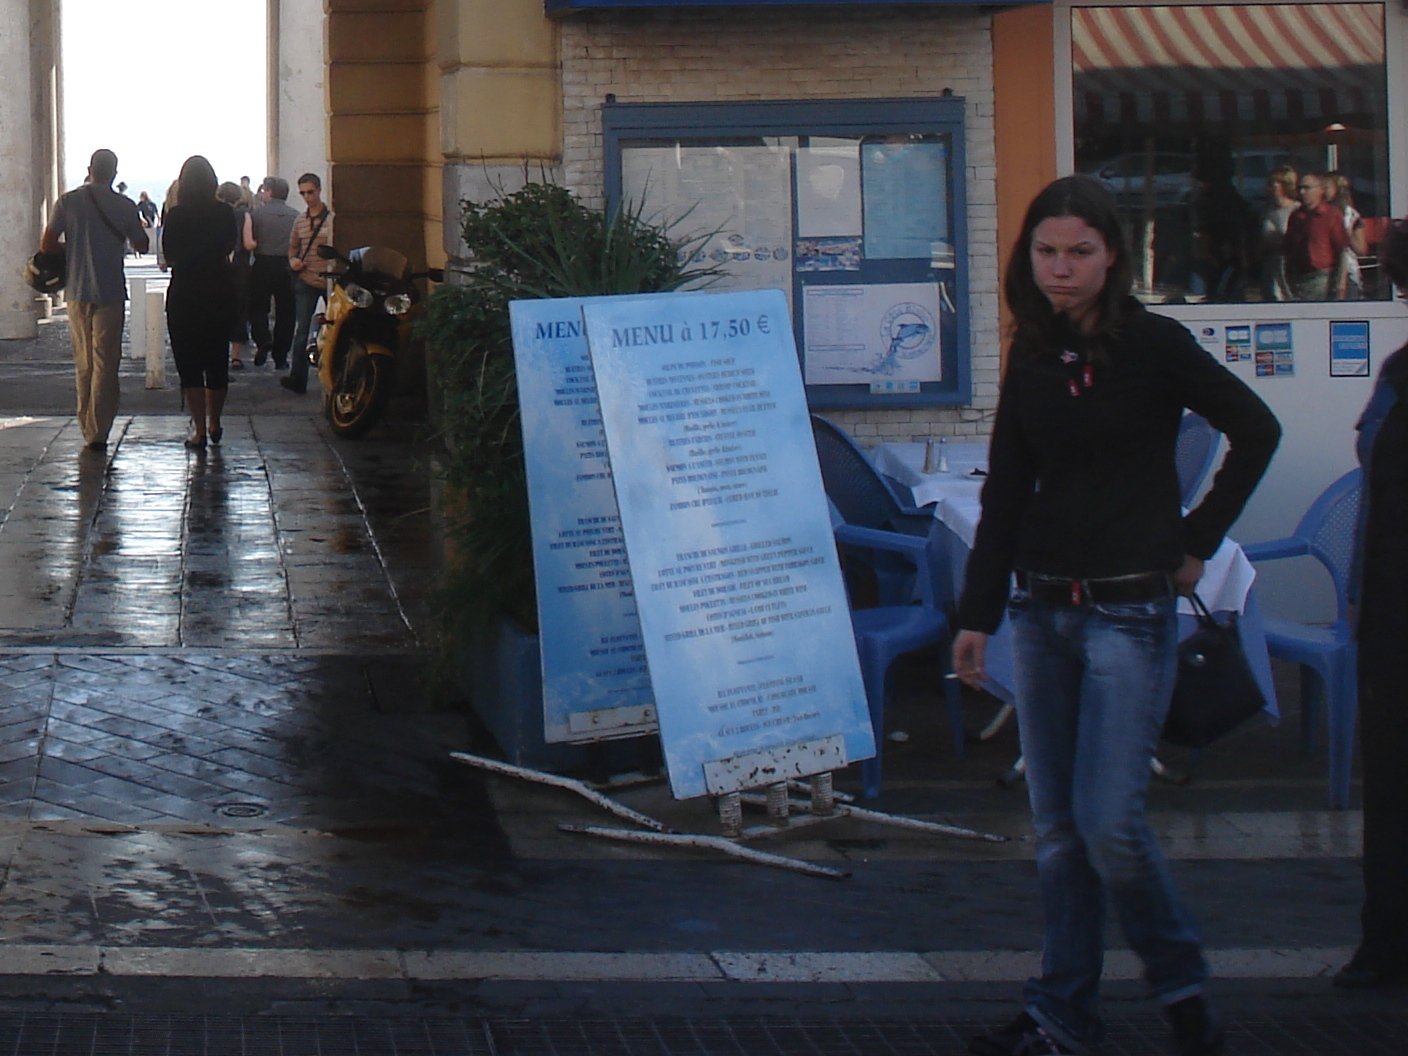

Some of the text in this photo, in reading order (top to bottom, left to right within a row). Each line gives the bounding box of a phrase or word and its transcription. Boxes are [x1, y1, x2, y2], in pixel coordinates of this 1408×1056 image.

[612, 314, 771, 348] MENU à 17,50 €
